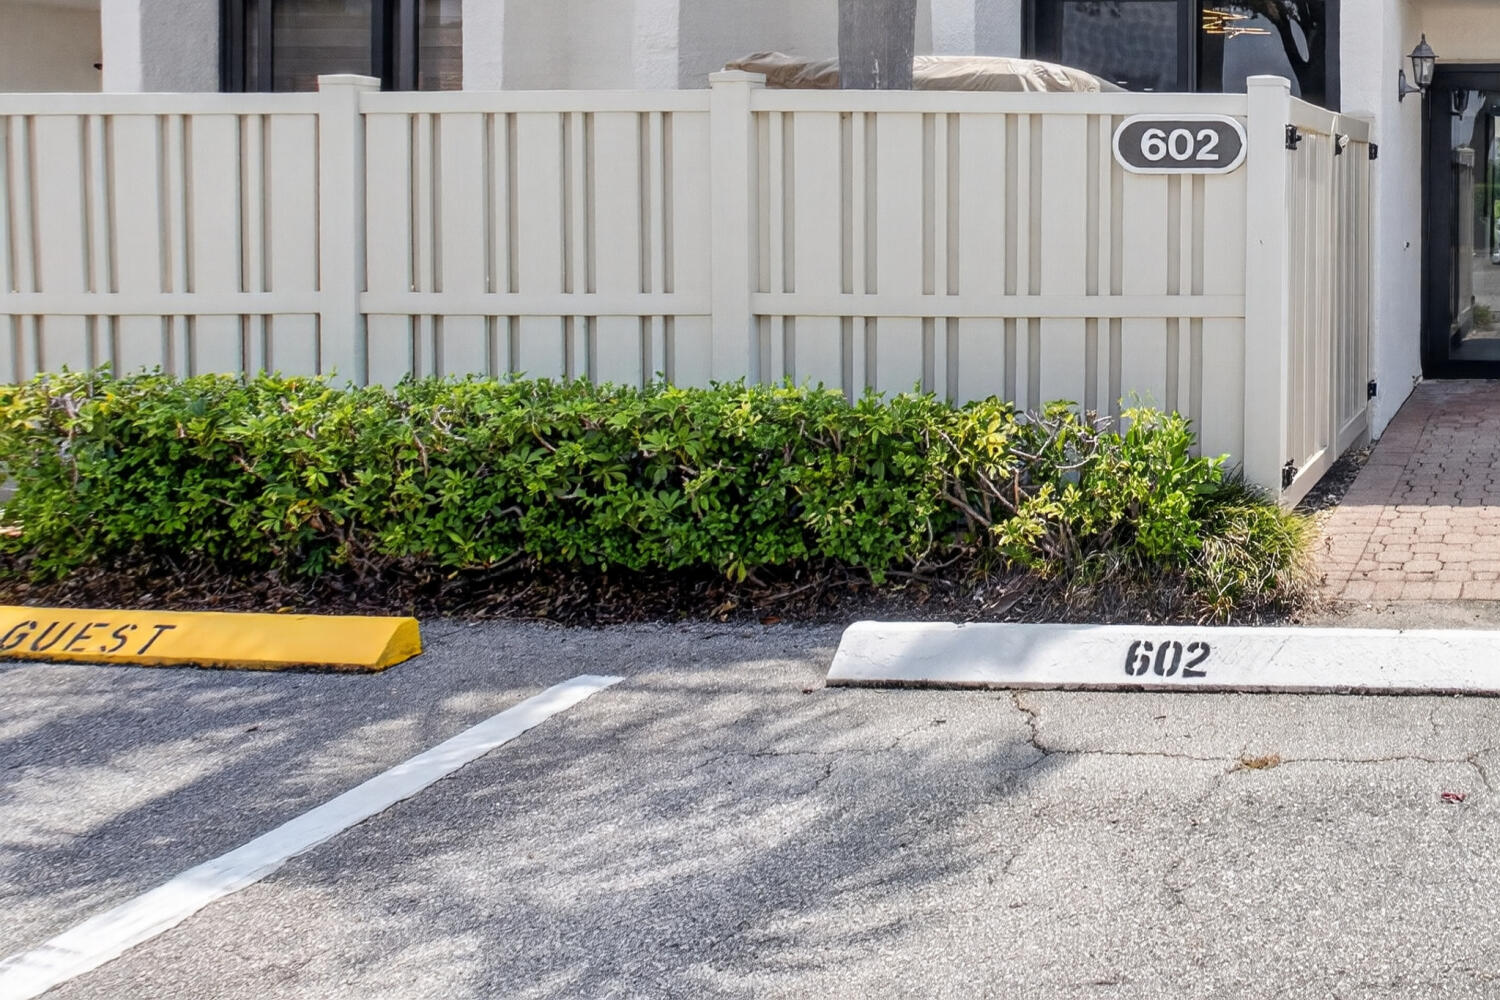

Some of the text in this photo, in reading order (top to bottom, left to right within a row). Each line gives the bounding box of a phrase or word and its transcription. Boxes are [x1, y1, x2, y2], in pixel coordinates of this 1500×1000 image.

[1140, 128, 1219, 161] 602
[0, 620, 177, 656] GUEST
[1124, 640, 1210, 678] 602
